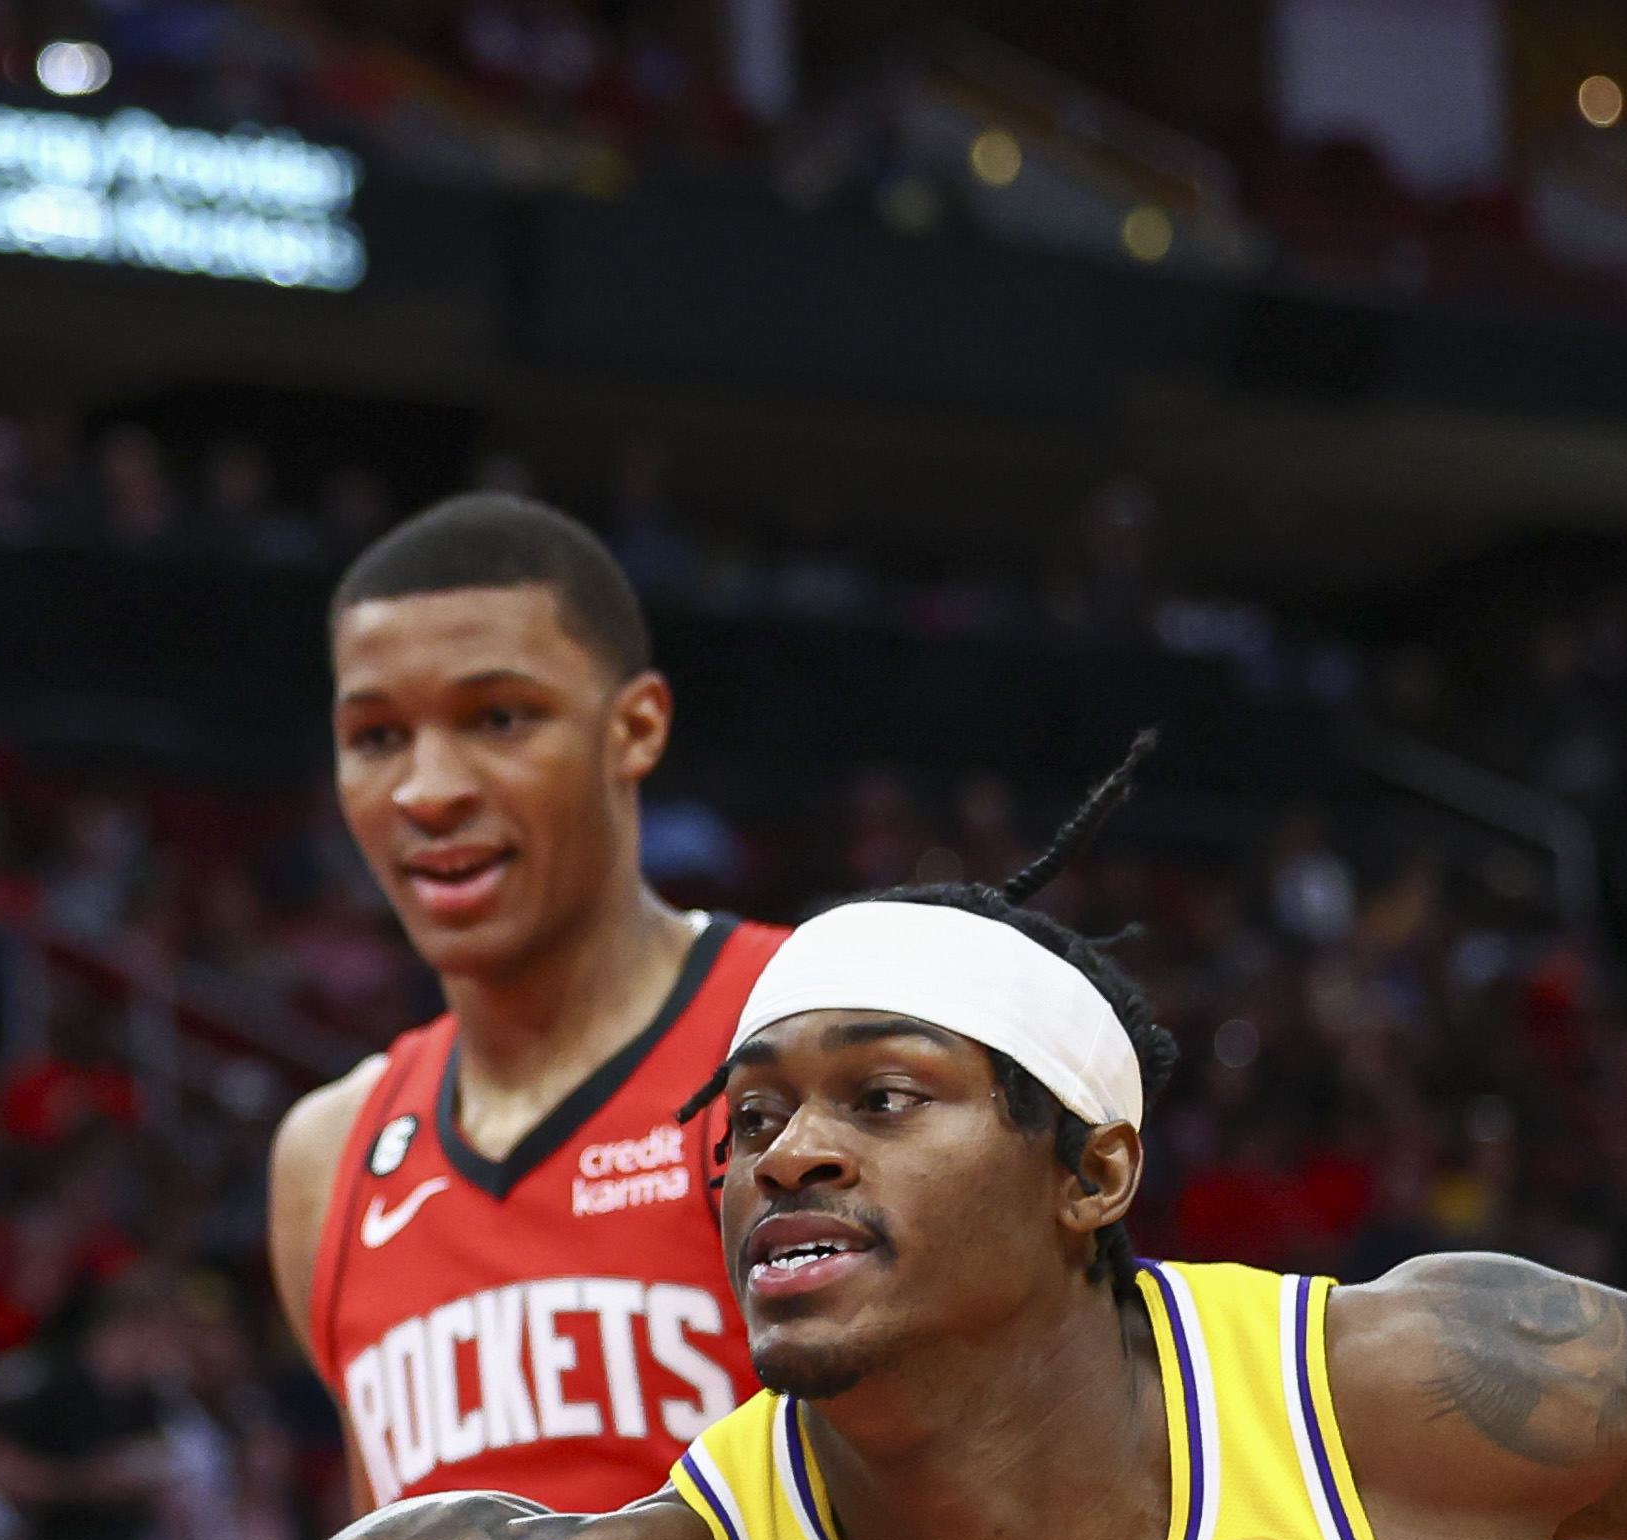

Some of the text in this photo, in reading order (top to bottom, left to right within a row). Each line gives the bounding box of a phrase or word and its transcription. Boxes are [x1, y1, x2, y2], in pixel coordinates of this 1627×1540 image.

[579, 1124, 683, 1179] credit
[571, 1166, 689, 1217] karma
[344, 1277, 737, 1507] ROCKETS
